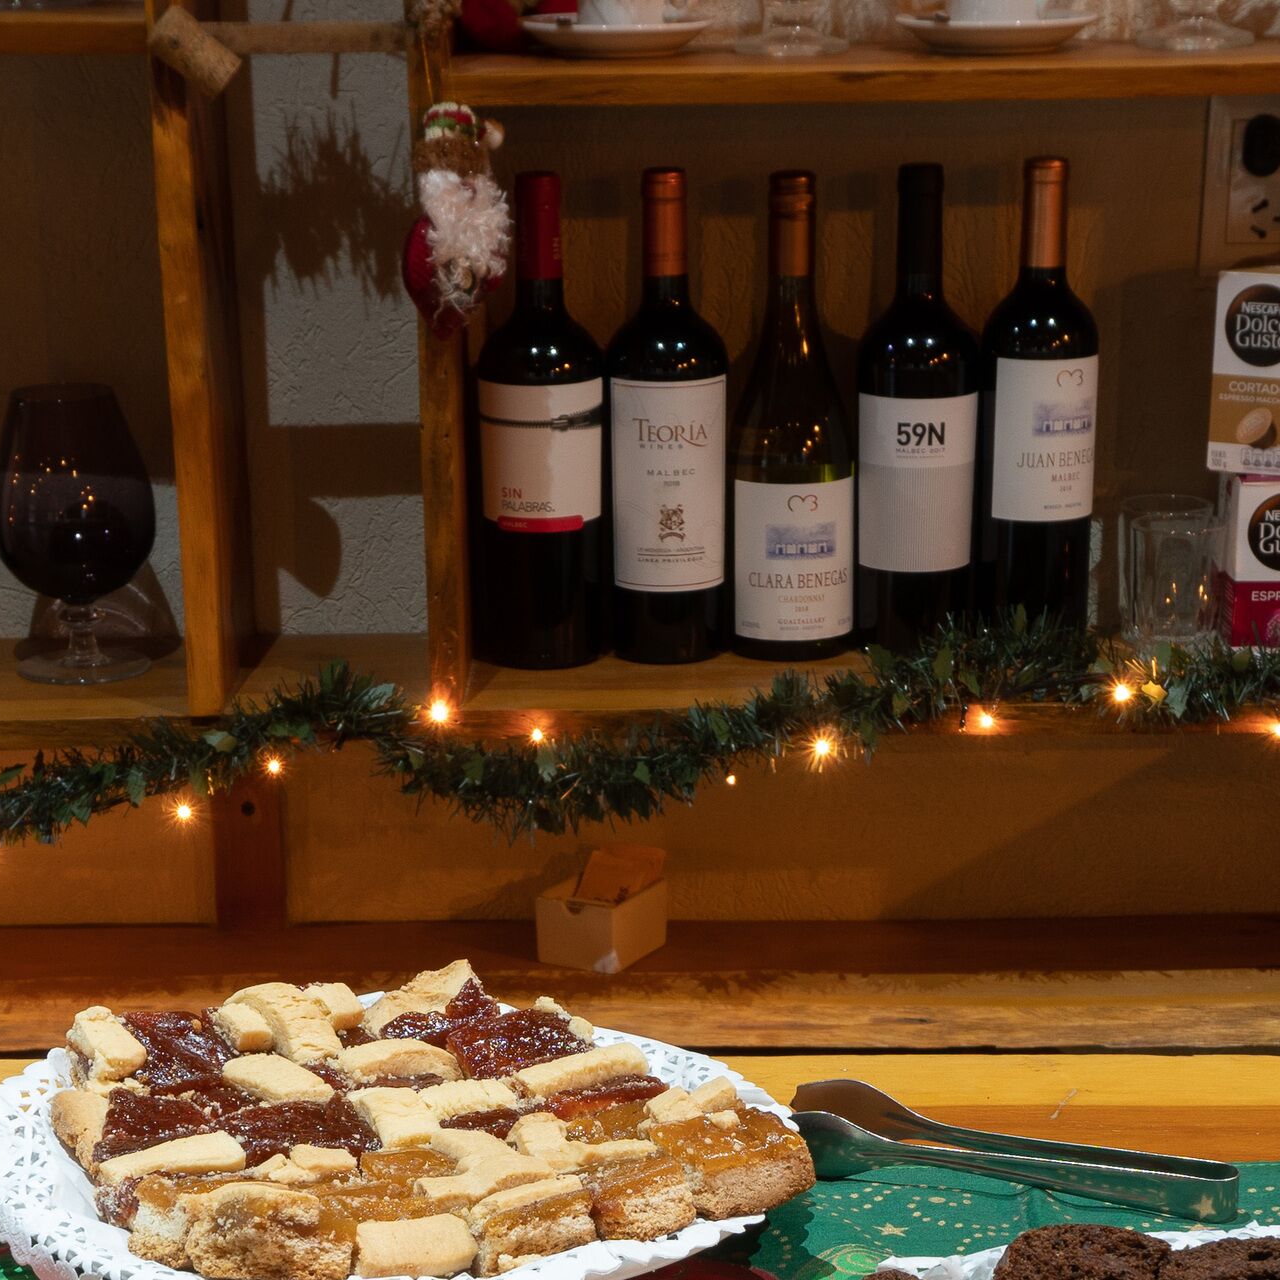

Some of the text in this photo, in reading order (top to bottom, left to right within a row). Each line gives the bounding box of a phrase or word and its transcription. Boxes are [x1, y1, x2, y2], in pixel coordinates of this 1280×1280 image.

[896, 421, 946, 447] 59N
[1016, 451, 1056, 469] JUAN
[646, 468, 697, 477] MALBEC
[1051, 471, 1081, 482] MALBEC
[501, 487, 523, 499] SIN
[748, 567, 848, 589] CLARA BENEGAS
